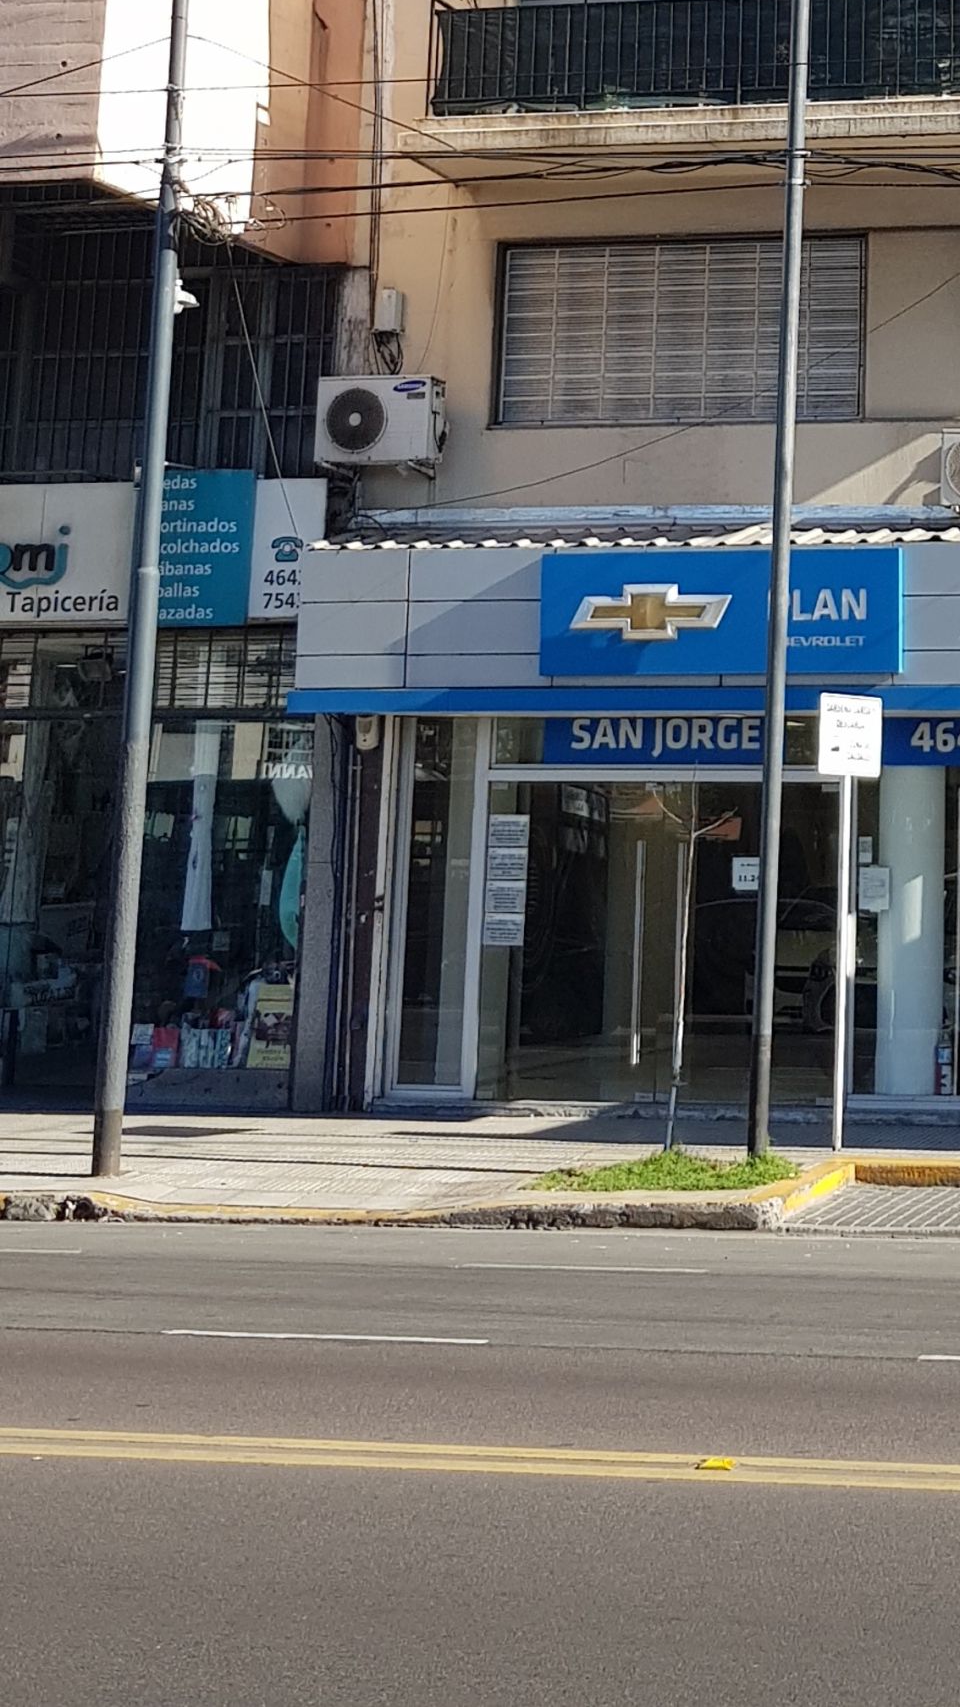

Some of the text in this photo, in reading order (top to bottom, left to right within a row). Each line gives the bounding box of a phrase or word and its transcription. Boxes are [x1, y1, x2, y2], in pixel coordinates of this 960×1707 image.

[163, 475, 197, 489] edas
[161, 498, 195, 511] anas
[160, 518, 237, 533] ortinados
[160, 539, 240, 554] colchados
[159, 563, 212, 576] ábanas
[263, 570, 301, 586] 464
[6, 589, 120, 618] Tapicería
[262, 592, 301, 610] 754
[768, 588, 867, 621] LAN
[787, 635, 865, 647] EVROLET
[571, 718, 761, 758] SAN JORGE
